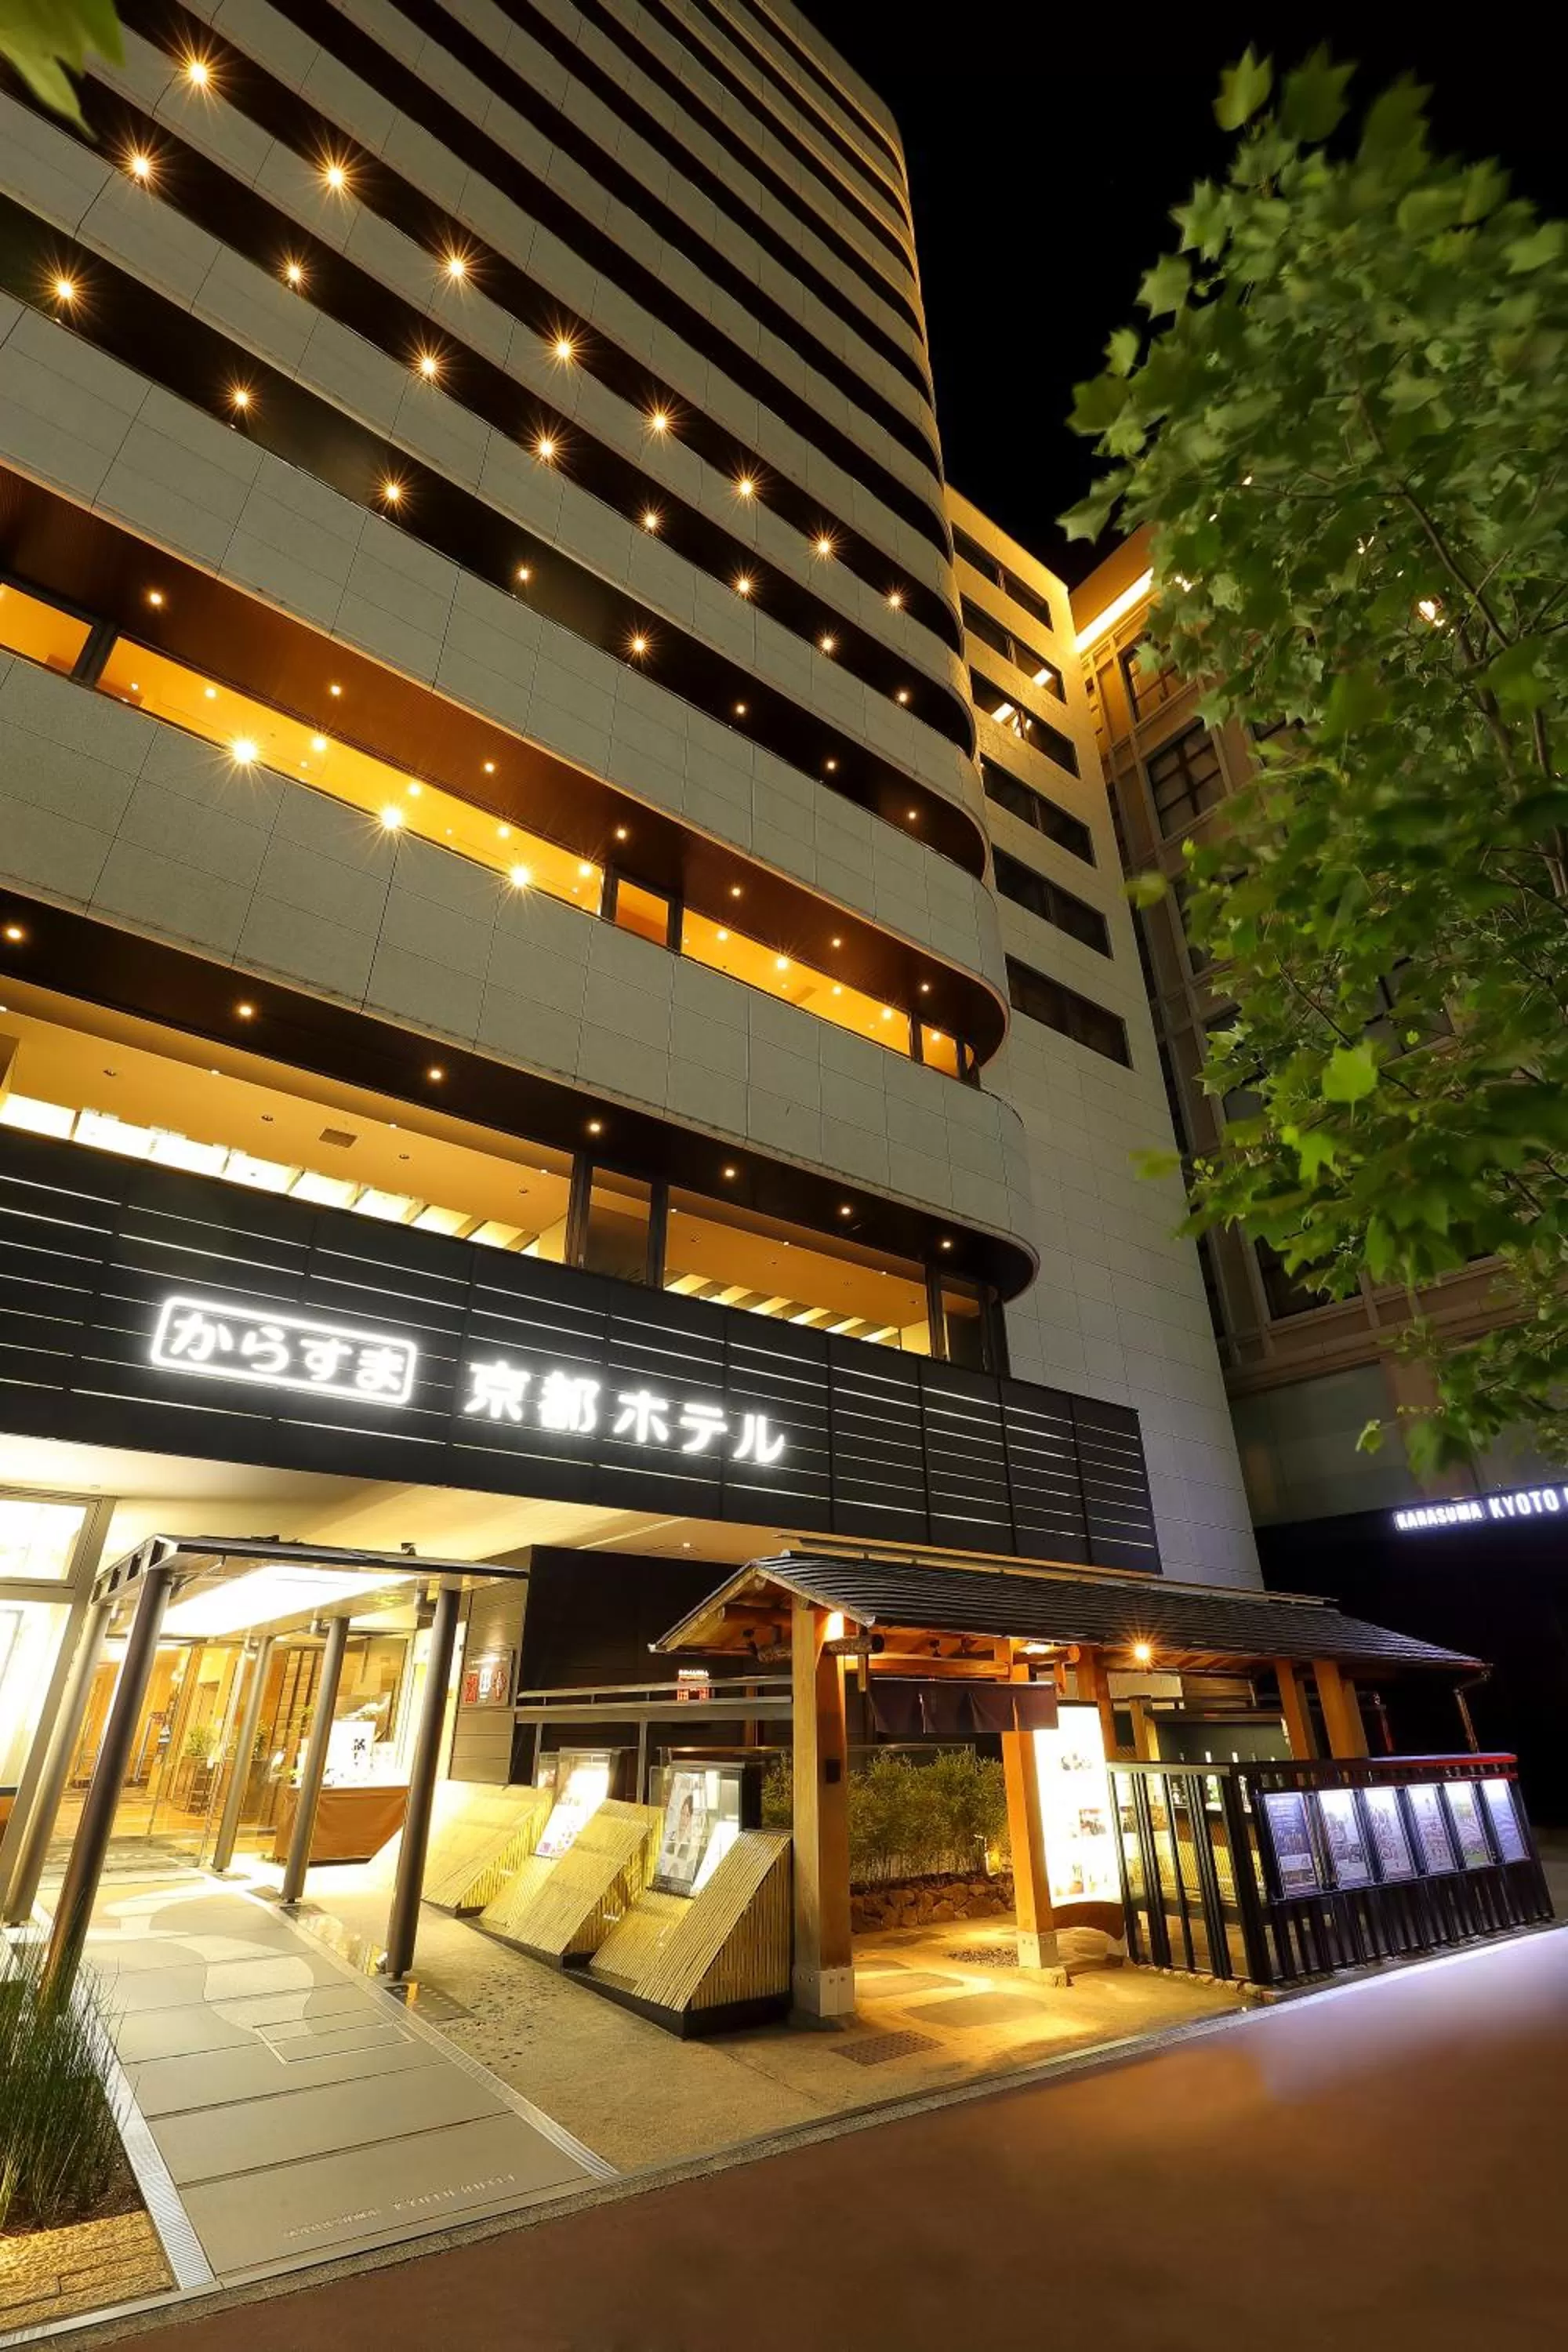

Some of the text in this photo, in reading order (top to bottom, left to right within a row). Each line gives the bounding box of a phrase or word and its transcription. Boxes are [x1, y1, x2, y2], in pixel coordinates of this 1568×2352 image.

[169, 1311, 786, 1465] からすま 京都ホテル
[1489, 1489, 1560, 1519] KYOTO
